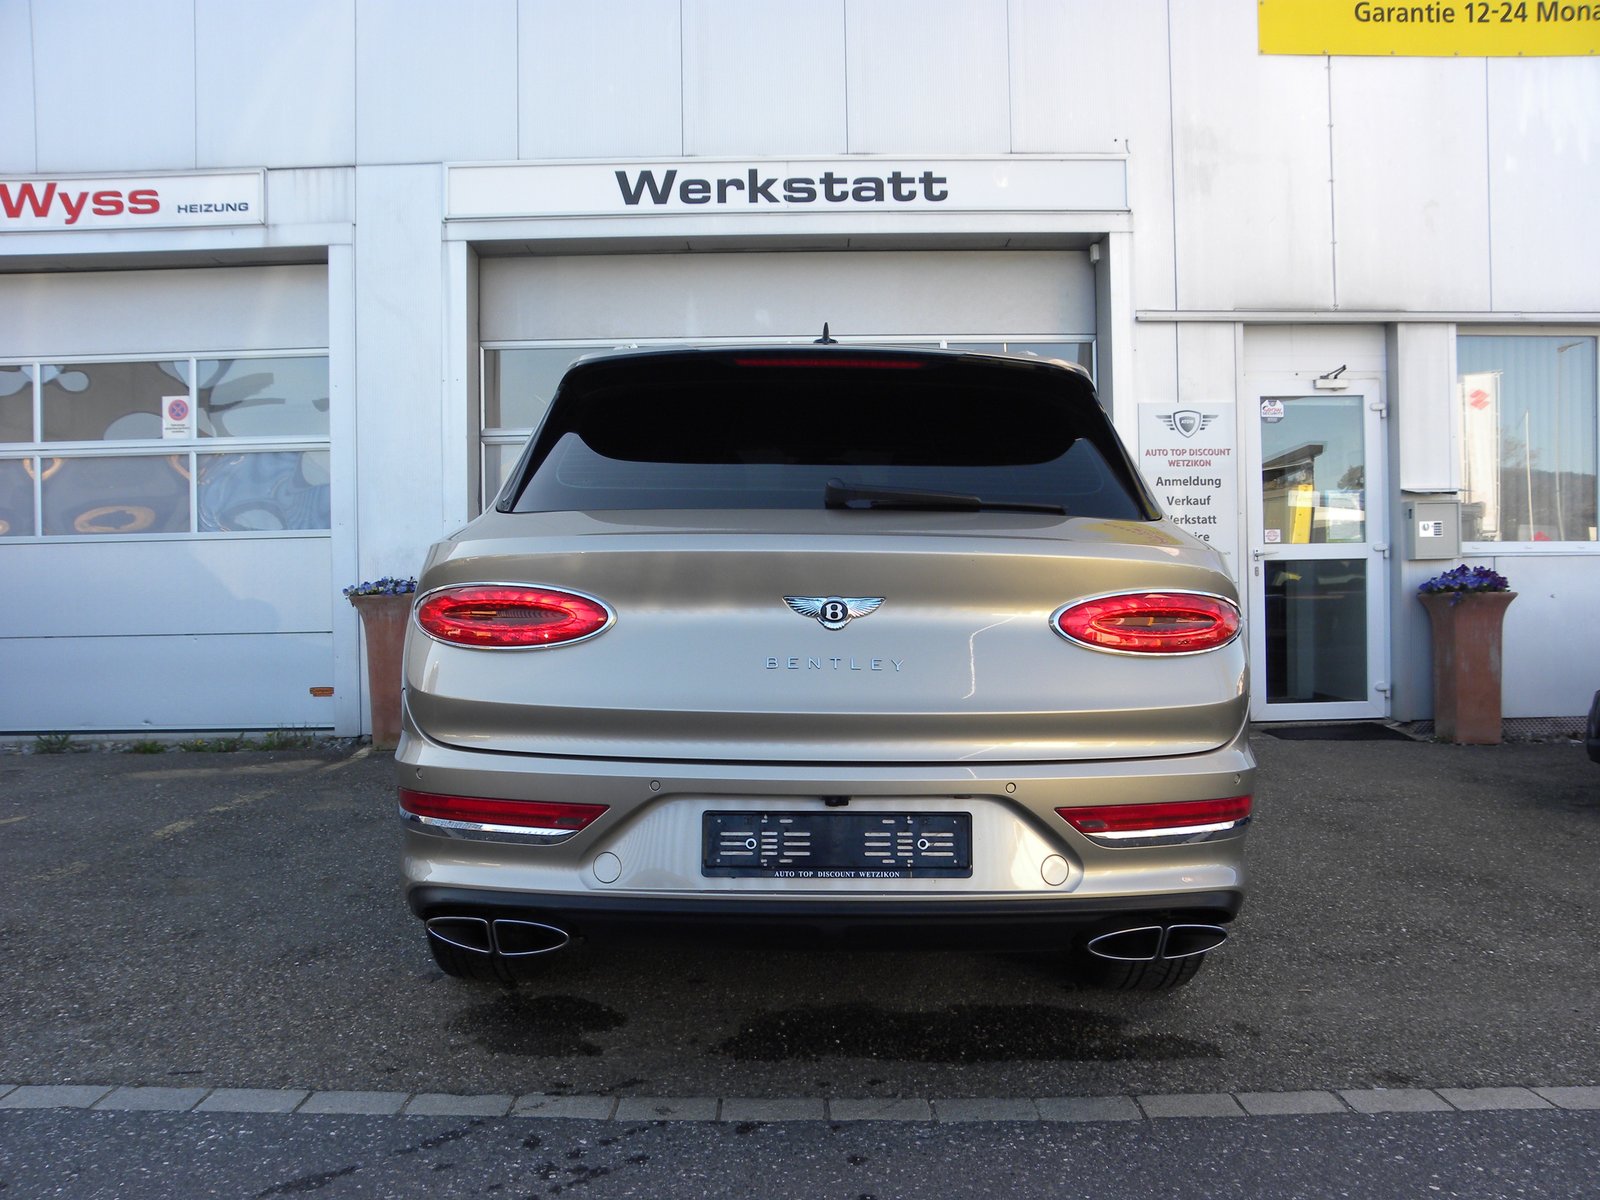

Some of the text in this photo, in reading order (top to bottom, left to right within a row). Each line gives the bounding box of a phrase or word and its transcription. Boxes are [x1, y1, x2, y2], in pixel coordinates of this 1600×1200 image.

[1354, 1, 1455, 23] Garantie
[1464, 2, 1528, 23] 12-24
[614, 169, 949, 206] Werkstatt
[0, 182, 249, 225] Wyss HEIZUNG
[1145, 449, 1168, 457] AUTO
[1189, 448, 1231, 456] DISCOUNT
[1168, 459, 1212, 467] WETZIKON
[1156, 476, 1222, 488] Anmeldung
[1166, 495, 1212, 506] Verkauf
[1170, 514, 1217, 525] erkstatt
[825, 603, 843, 620] B
[765, 656, 905, 671] BENTLEY
